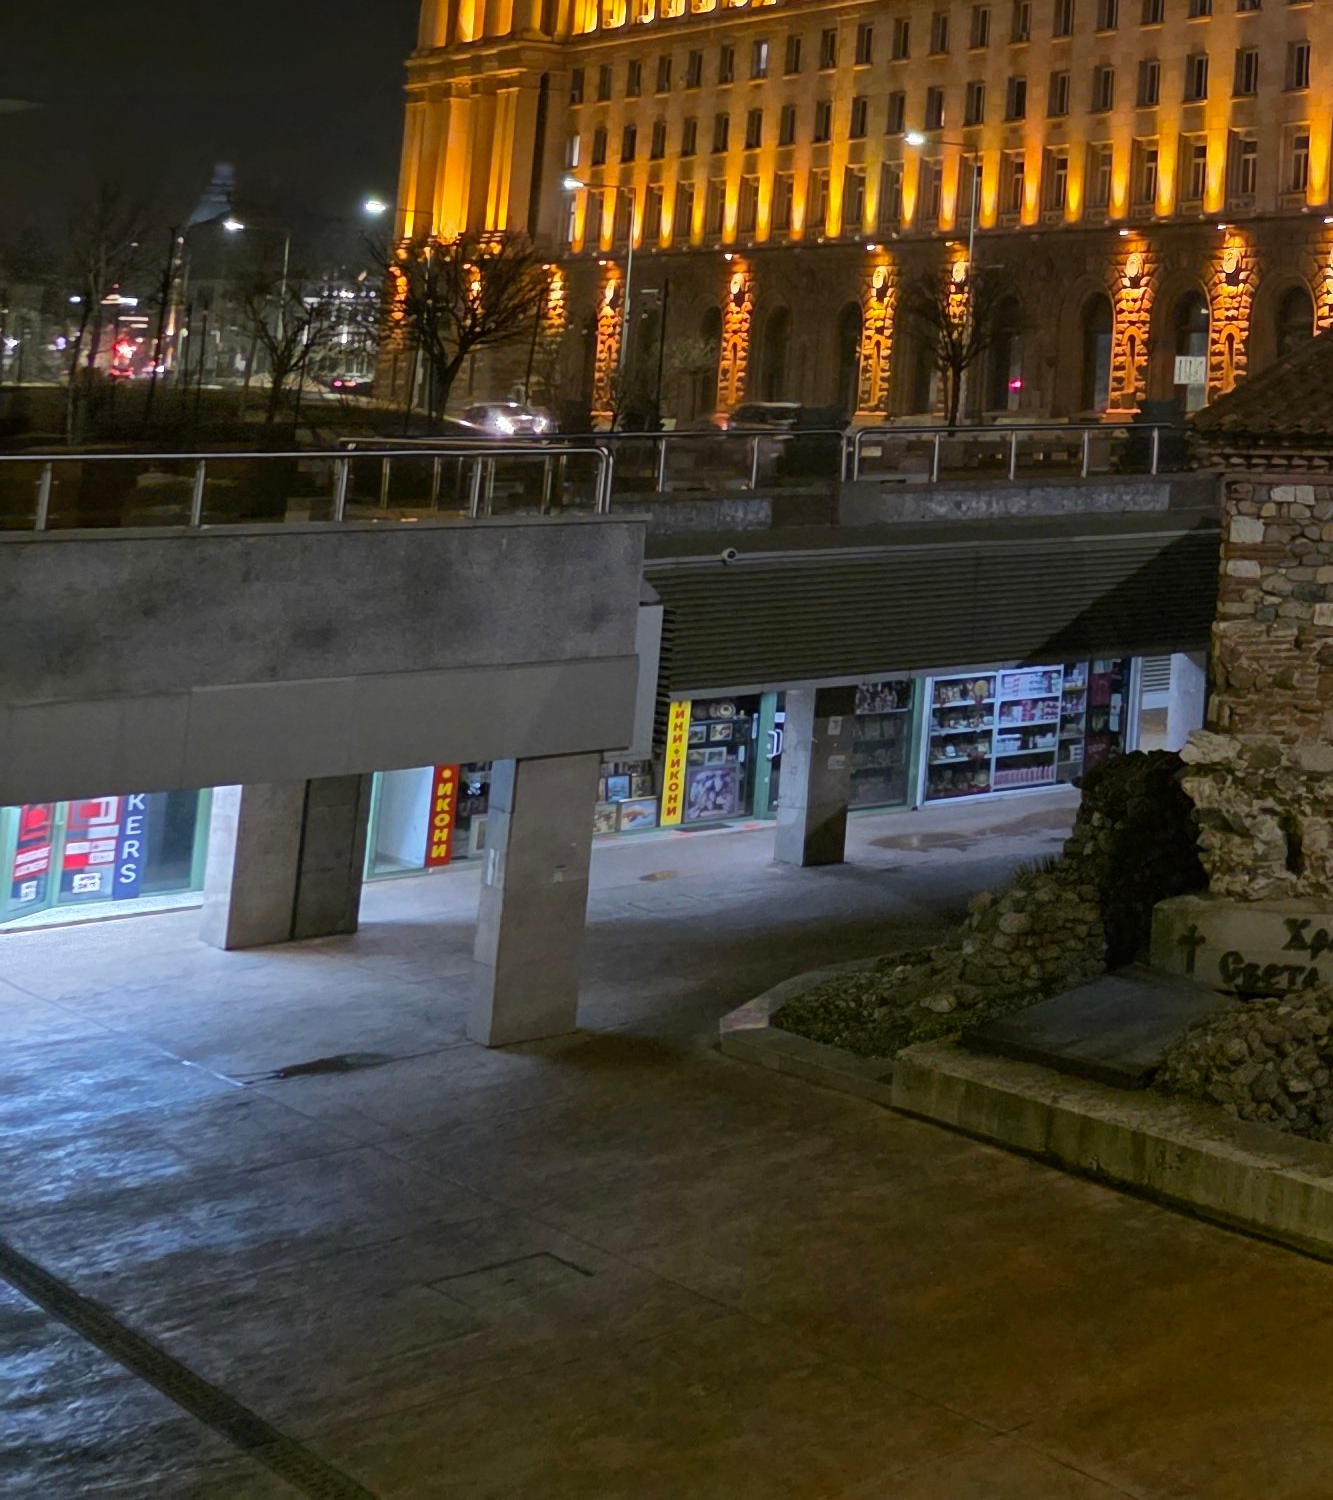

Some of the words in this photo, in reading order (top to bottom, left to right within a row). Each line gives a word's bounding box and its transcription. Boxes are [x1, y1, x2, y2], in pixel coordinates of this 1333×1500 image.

[431, 782, 453, 858] ИКОНИ
[666, 759, 681, 816] ИКОНИ
[119, 793, 145, 884] KERS
